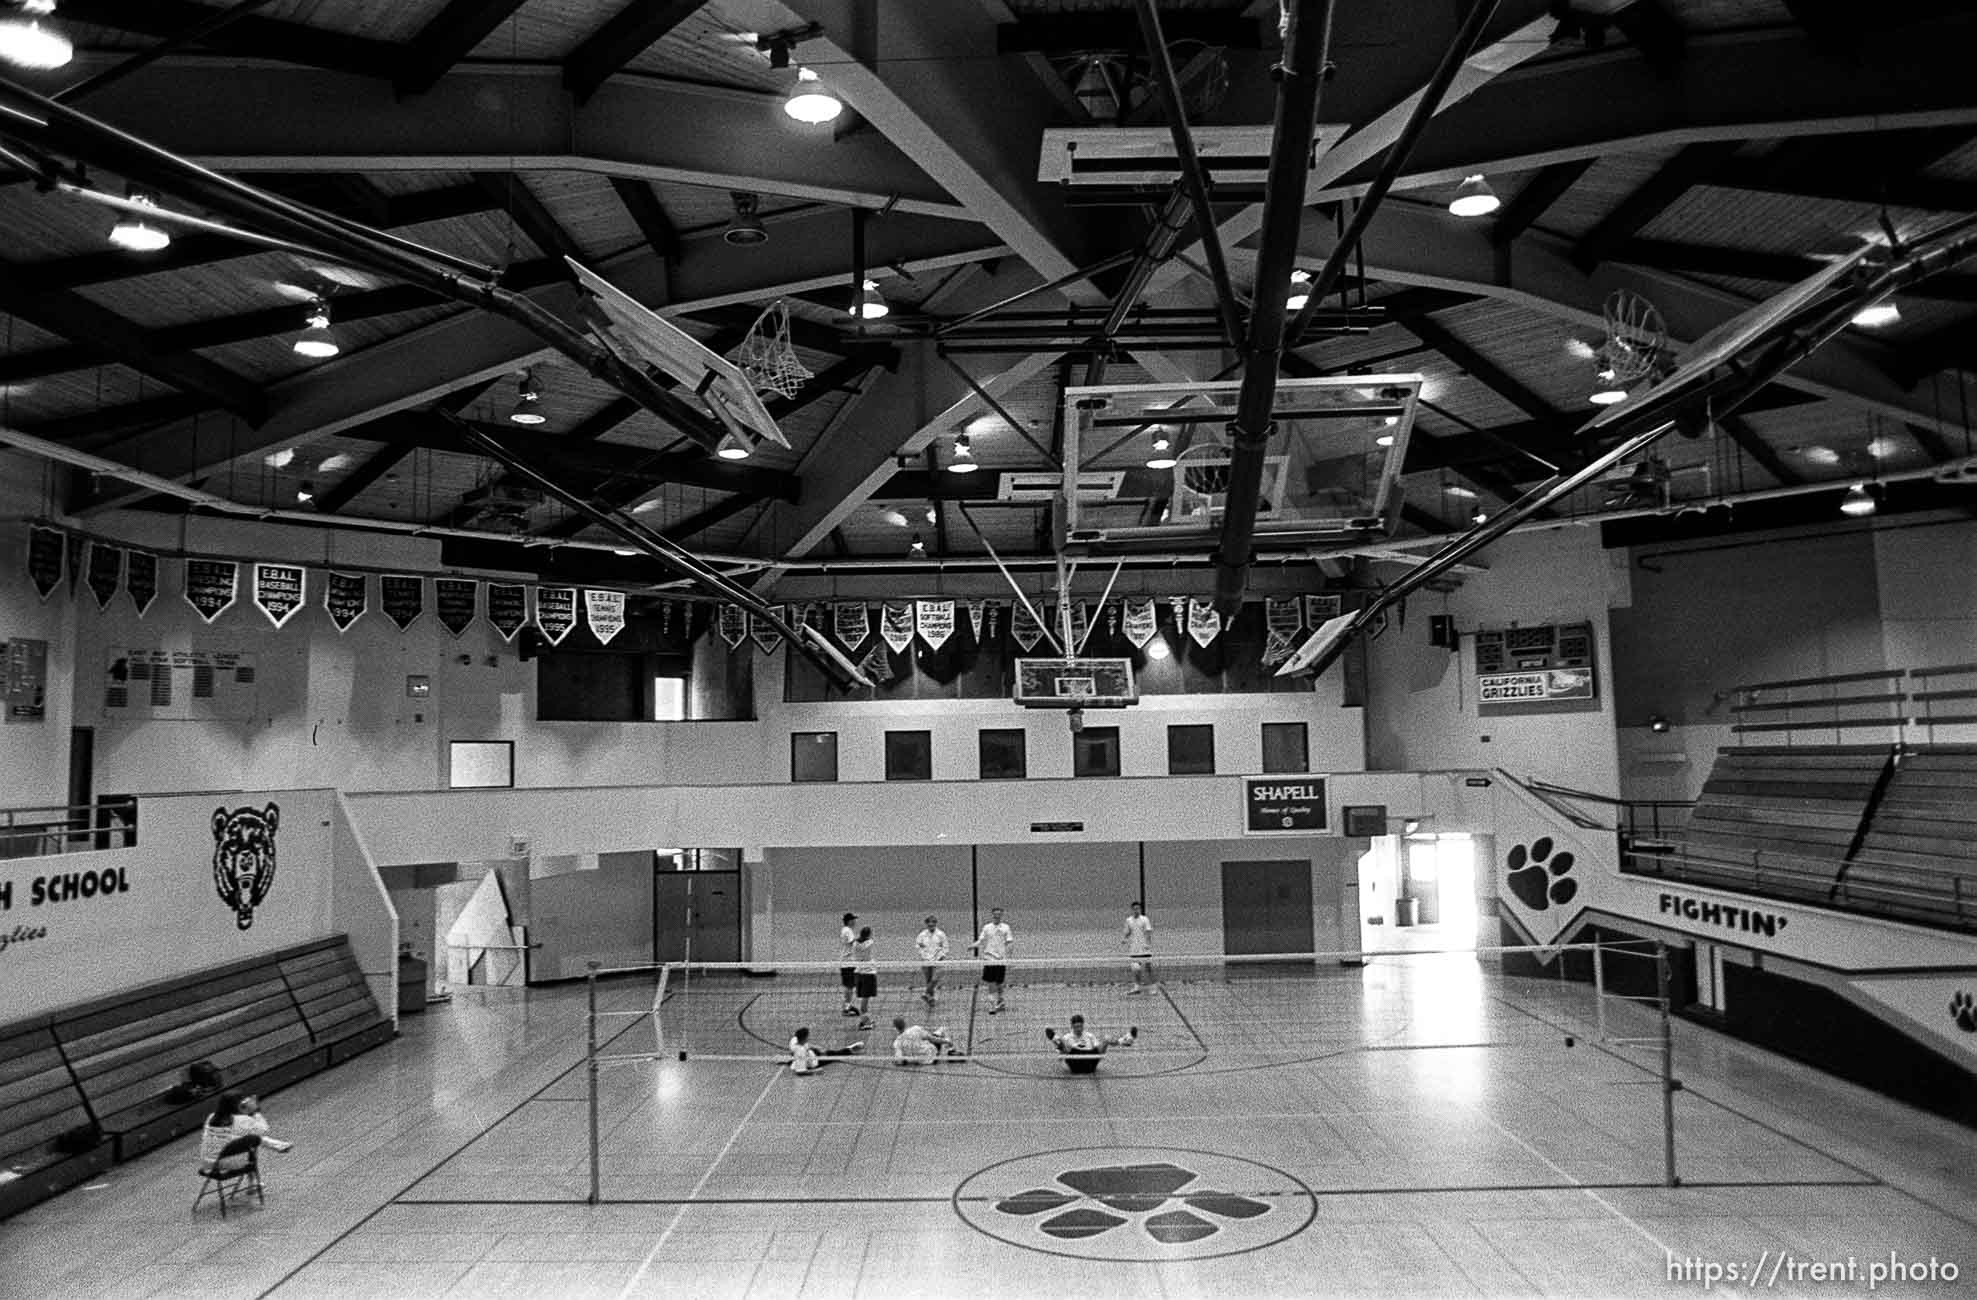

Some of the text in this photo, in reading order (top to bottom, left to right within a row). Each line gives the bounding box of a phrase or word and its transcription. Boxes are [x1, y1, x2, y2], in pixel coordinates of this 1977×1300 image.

[259, 580, 299, 592] BASEBALL
[267, 601, 290, 613] 1994
[920, 613, 951, 621] SOFTBALL
[1481, 676, 1542, 687] CALIFORNIA
[1482, 685, 1544, 699] GRIZZLIES
[1253, 785, 1320, 801] SHAPELL
[31, 867, 130, 907] SCHOOL
[1659, 892, 1788, 938] FIGHTIN'
